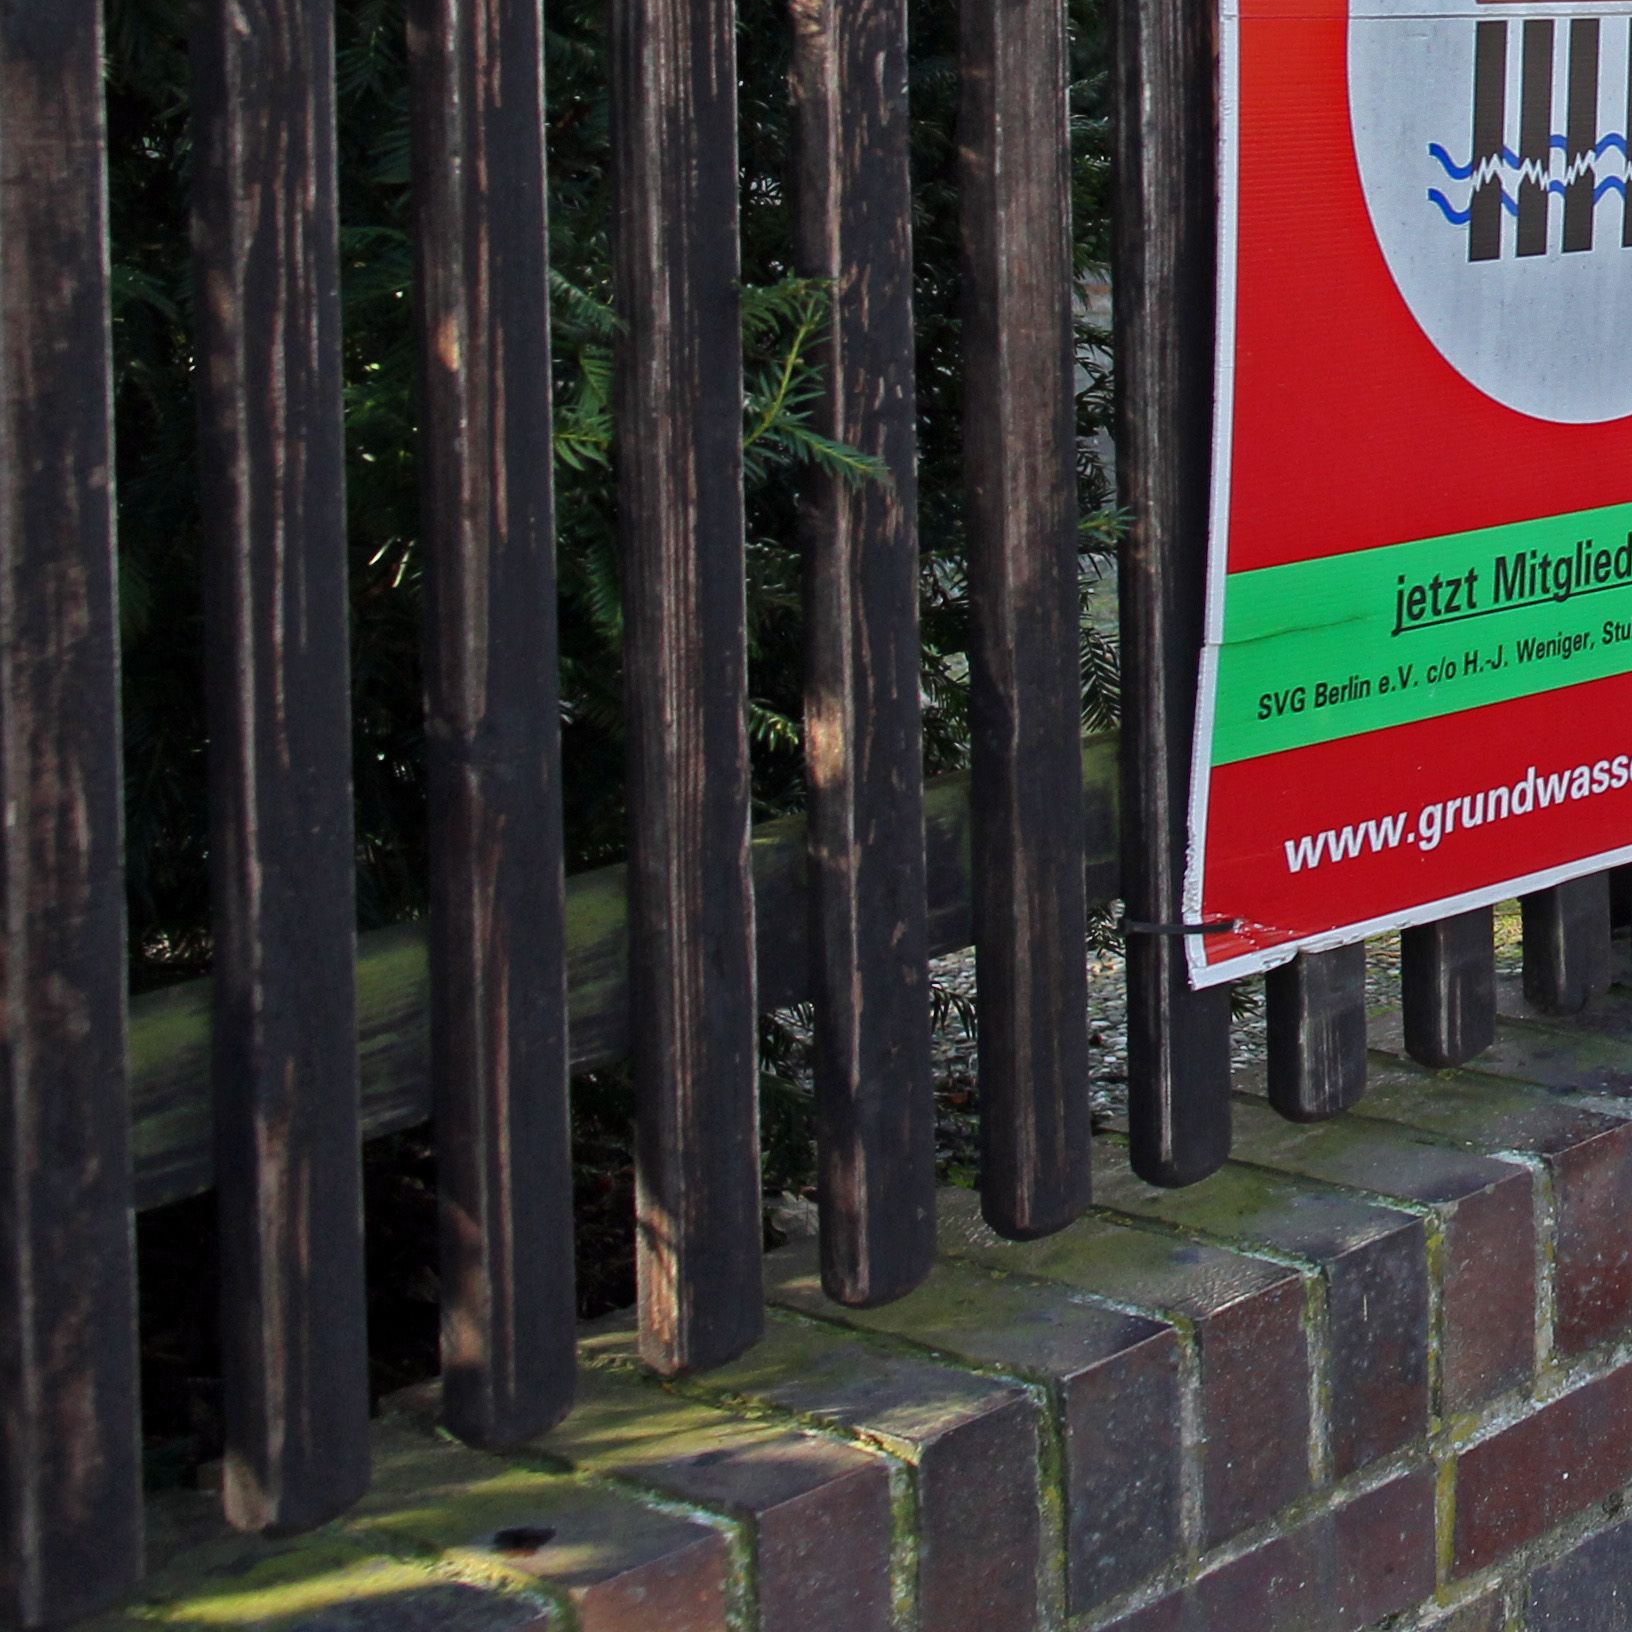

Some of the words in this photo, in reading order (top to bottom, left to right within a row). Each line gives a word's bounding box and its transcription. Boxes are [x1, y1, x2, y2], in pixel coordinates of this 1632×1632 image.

[1391, 567, 1478, 636] jetzt
[1257, 686, 1306, 721] SVG
[1314, 675, 1371, 708] Berlin
[1378, 664, 1418, 694] e.V.
[1426, 658, 1457, 685] c/o
[1464, 644, 1509, 676] H.-J.
[1516, 630, 1595, 664] Weniger,
